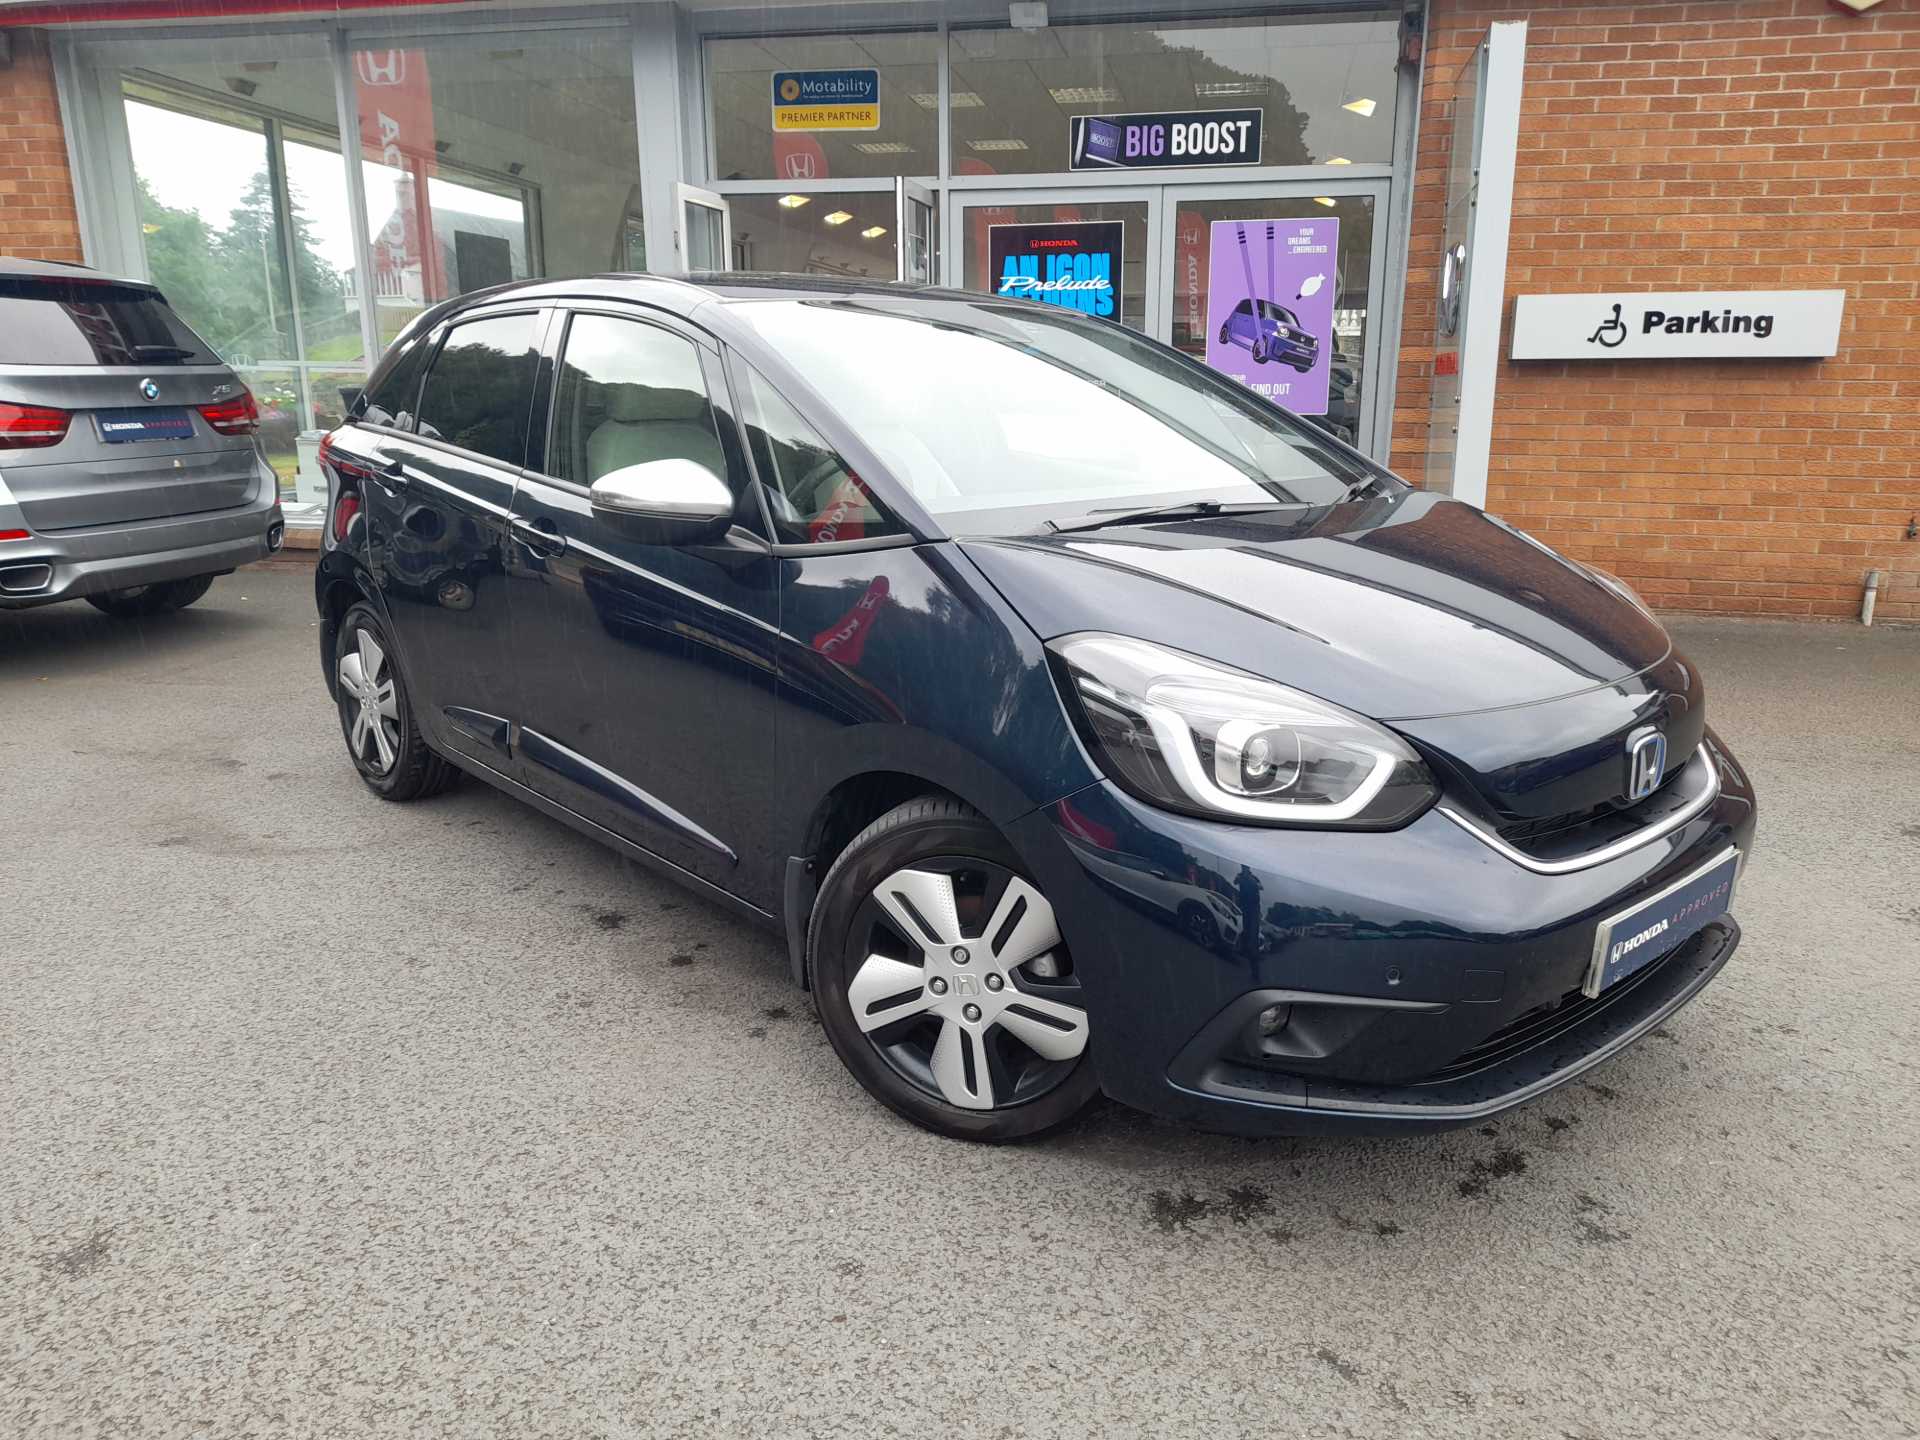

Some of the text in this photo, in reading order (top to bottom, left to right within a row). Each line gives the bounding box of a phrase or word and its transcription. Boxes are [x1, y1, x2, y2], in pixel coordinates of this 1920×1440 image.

[801, 78, 872, 95] Motability
[781, 111, 872, 122] PREMIER PARTNER
[1125, 121, 1252, 157] BIG BOOST
[1001, 252, 1111, 286] AN ICON
[1000, 275, 1111, 293] Prelude
[1642, 309, 1774, 338] Parking
[1273, 383, 1290, 395] OUT
[1623, 881, 1730, 954] HONDA APPROVED
